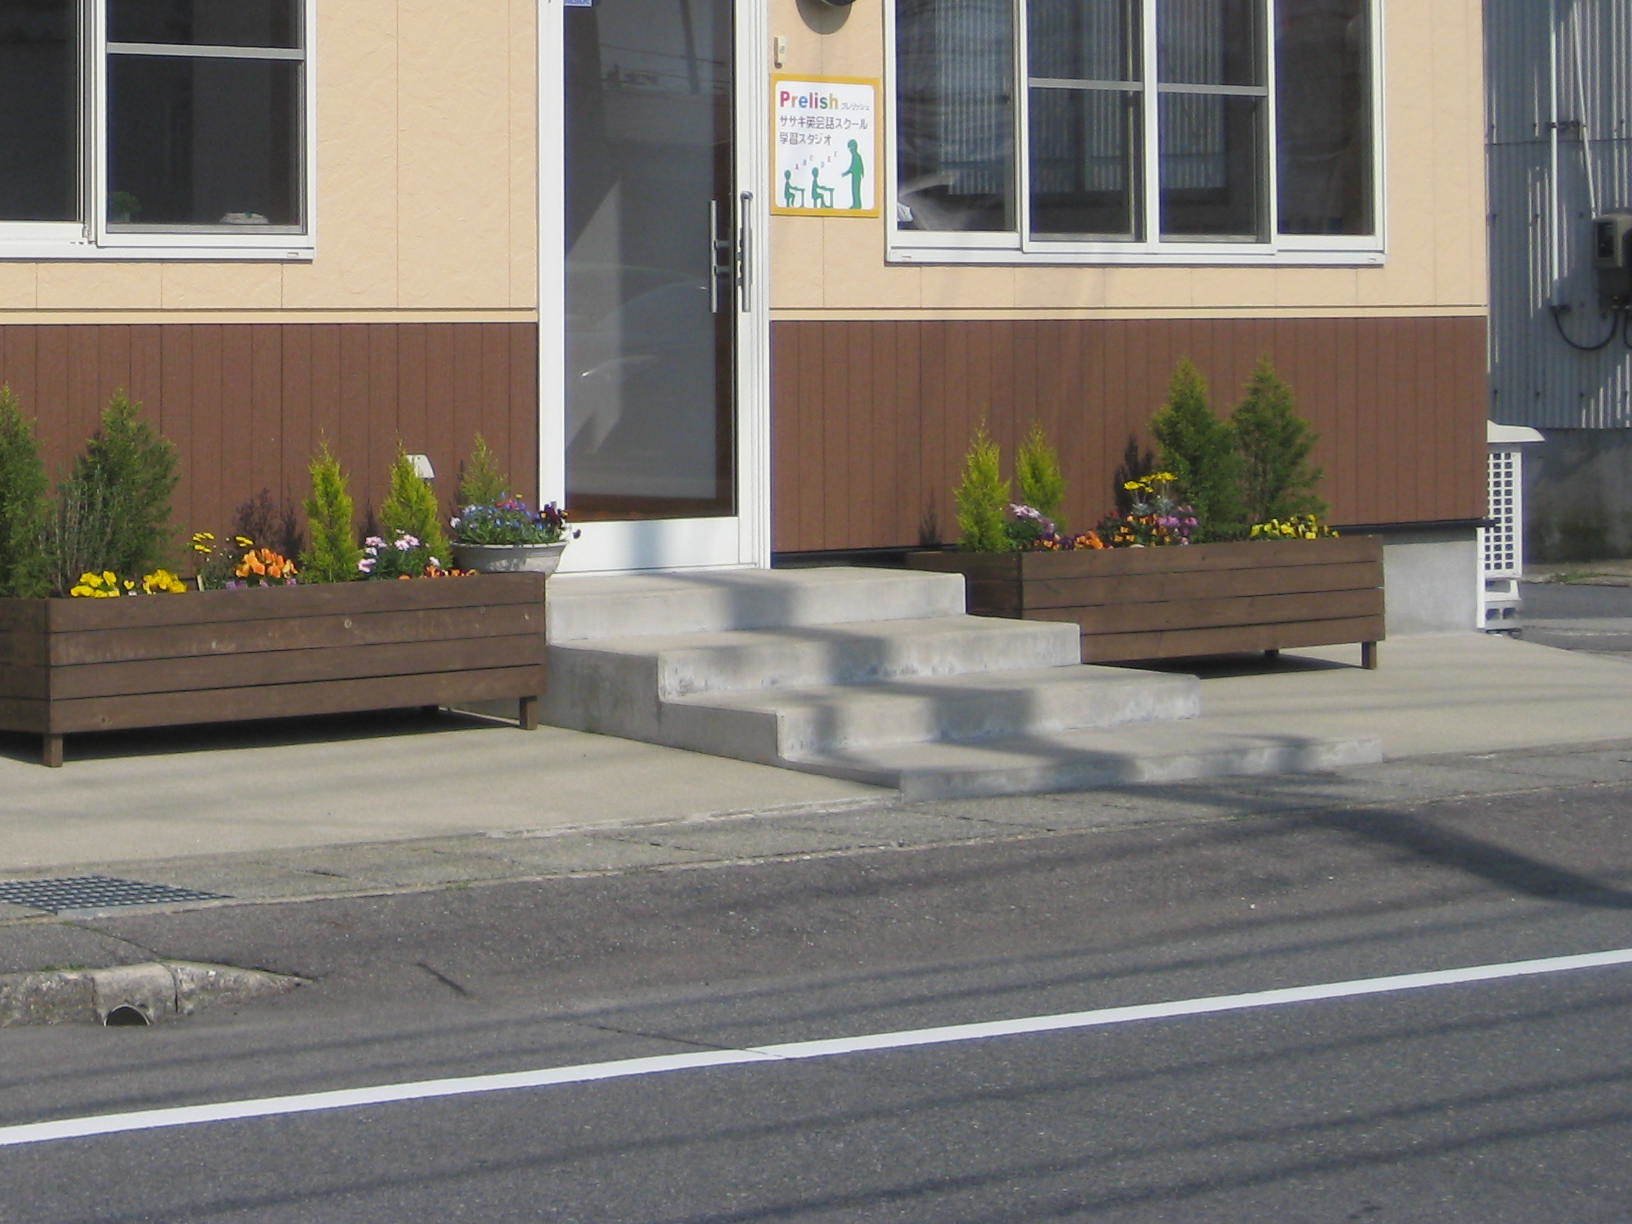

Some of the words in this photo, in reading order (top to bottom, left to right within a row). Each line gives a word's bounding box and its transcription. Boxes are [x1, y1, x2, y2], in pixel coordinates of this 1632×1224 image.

[779, 90, 839, 111] Prelish
[779, 114, 869, 131] ササキ英会話スクール
[779, 130, 833, 146] 学習スタジオ
